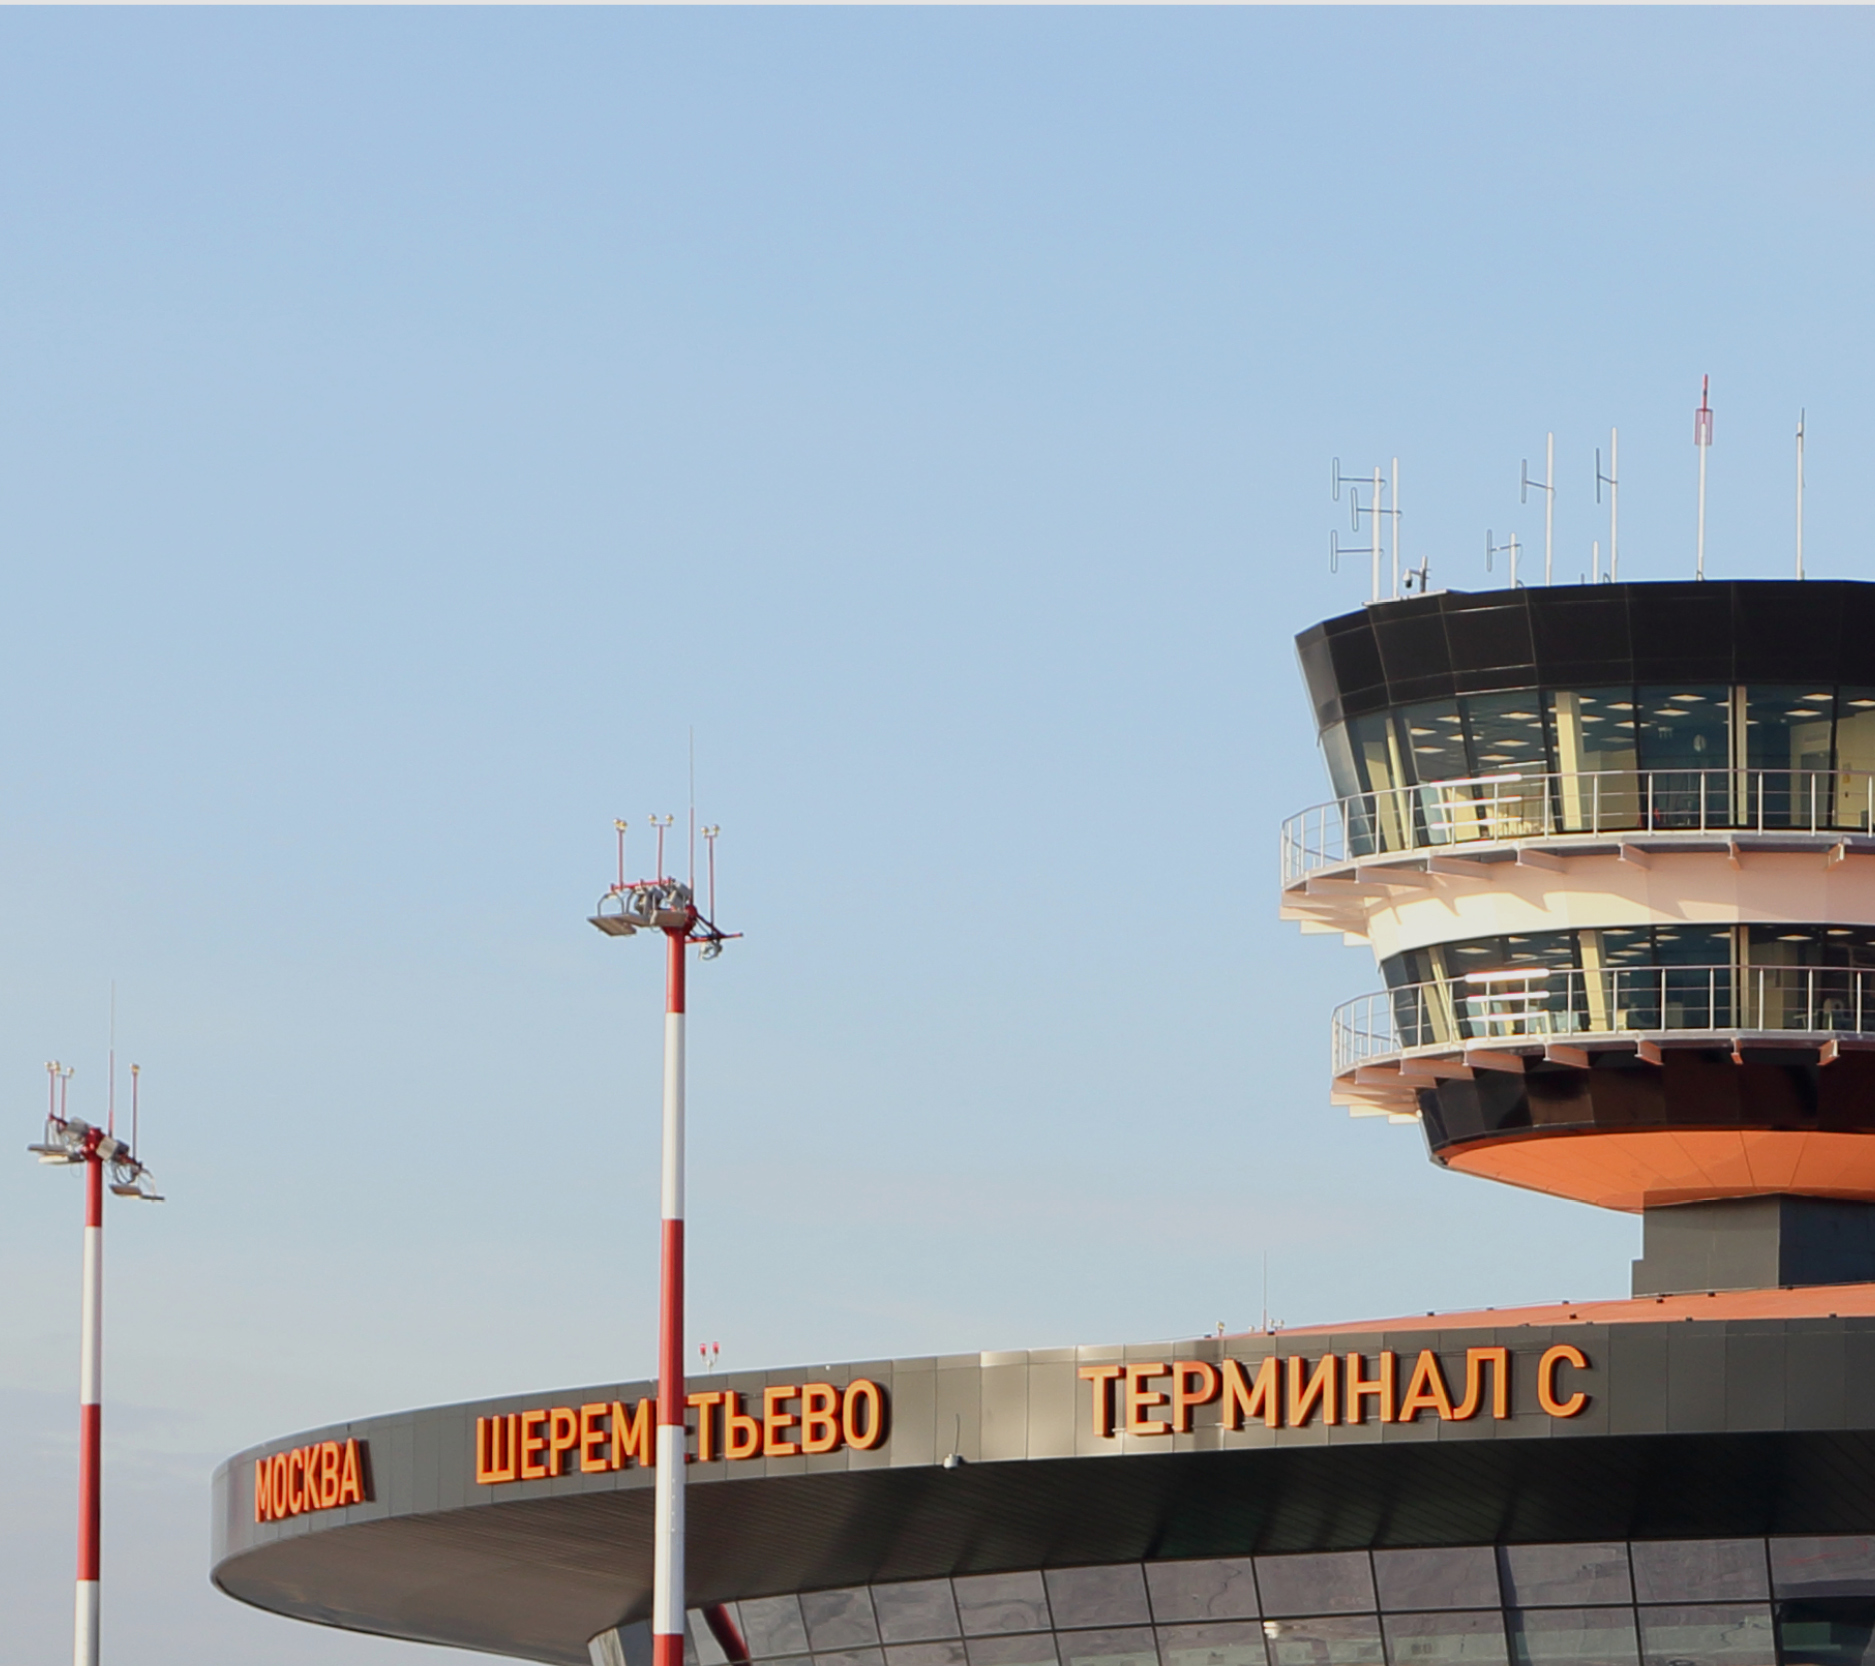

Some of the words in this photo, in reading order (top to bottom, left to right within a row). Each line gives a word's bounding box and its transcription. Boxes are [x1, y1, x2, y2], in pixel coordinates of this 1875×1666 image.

[475, 1377, 884, 1485] ШЕРЕМТЬЕВО
[1078, 1346, 1509, 1437] ТЕРМИНАЛ
[1537, 1343, 1590, 1419] С
[253, 1436, 366, 1523] МОСКВА
